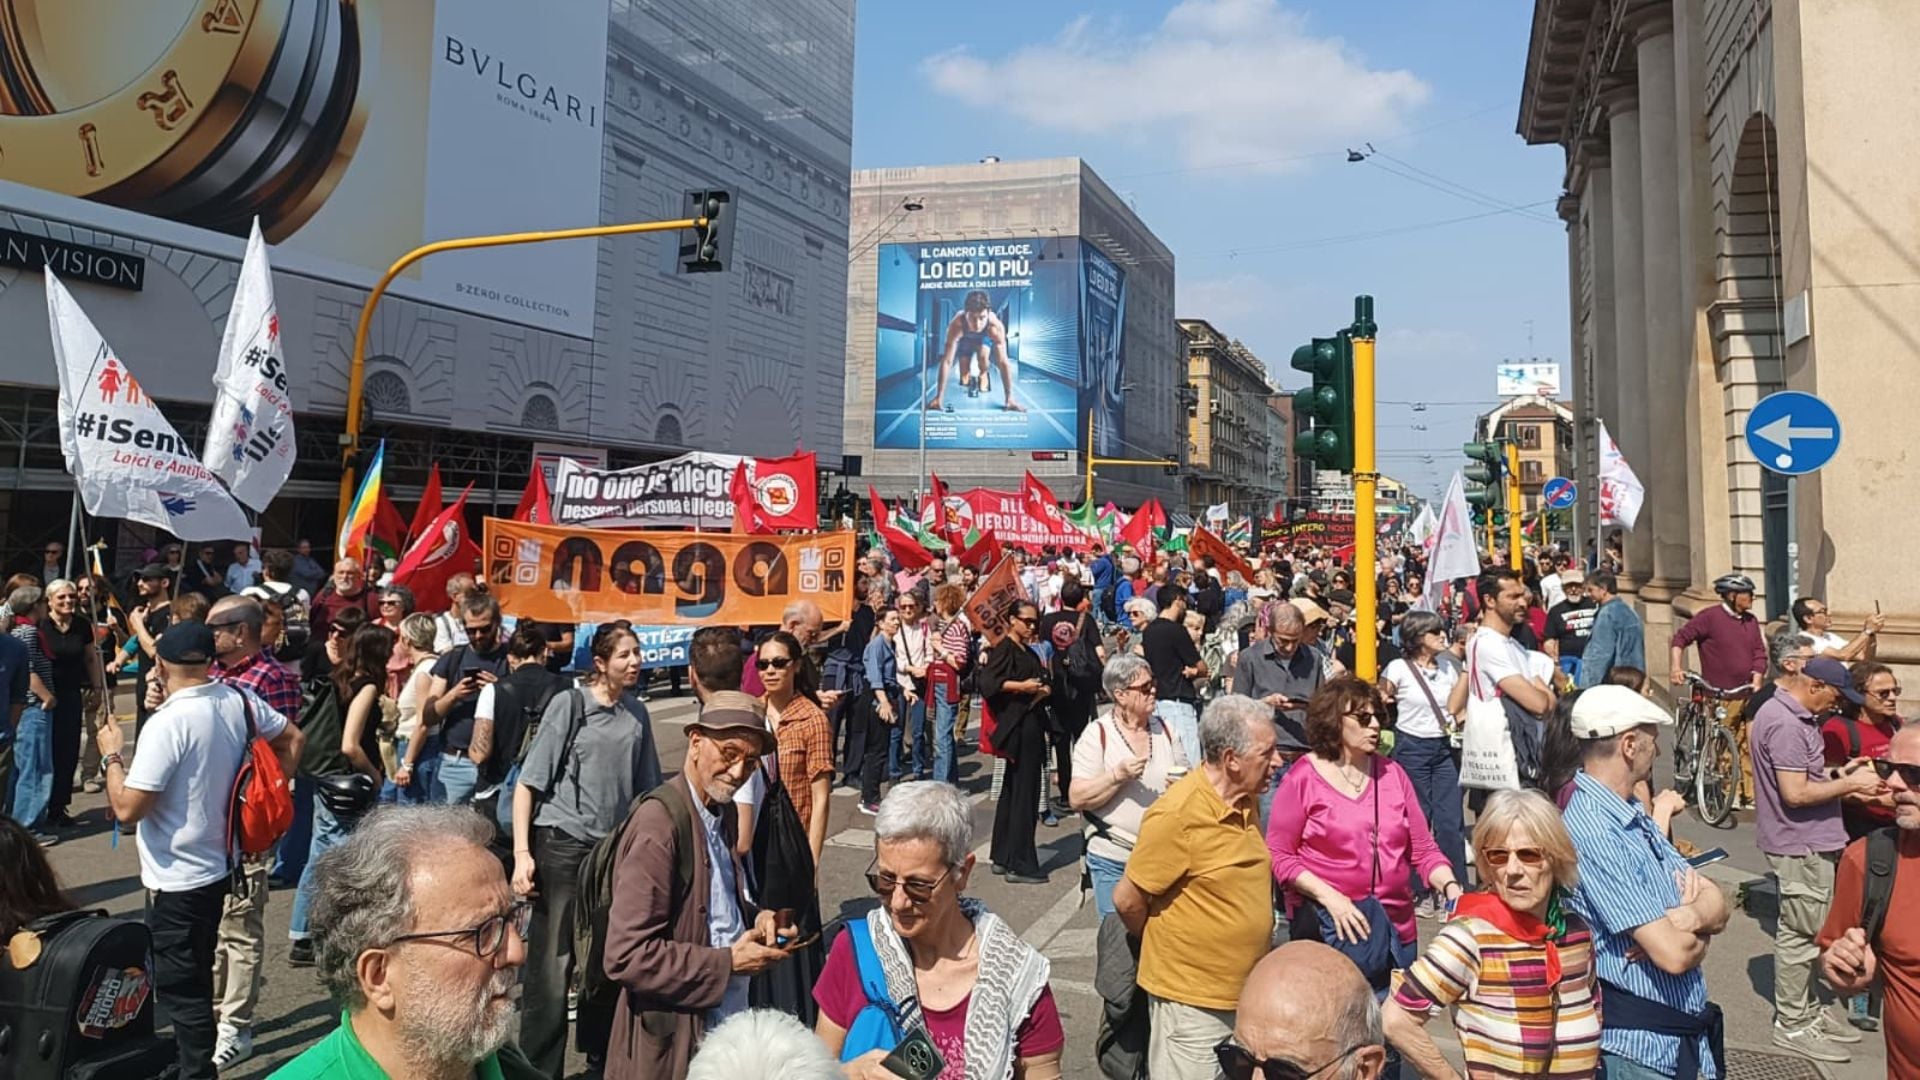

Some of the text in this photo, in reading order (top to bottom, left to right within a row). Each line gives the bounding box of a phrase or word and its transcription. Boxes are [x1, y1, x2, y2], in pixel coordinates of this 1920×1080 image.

[445, 35, 596, 128] BVLGARI
[0, 237, 139, 285] N VISION
[920, 244, 1033, 259] IL CANCRO È VELOCE.
[920, 255, 1033, 279] LO IEO DI PIÙ.
[503, 294, 570, 318] COLLECTION
[113, 450, 153, 469] Laici
[566, 474, 599, 500] no
[602, 476, 645, 500] one
[625, 499, 682, 518] persona
[1001, 498, 1025, 514] ALL
[976, 513, 1007, 531] VERDI
[551, 535, 789, 619] naga
[95, 978, 121, 1028] FUOCO
